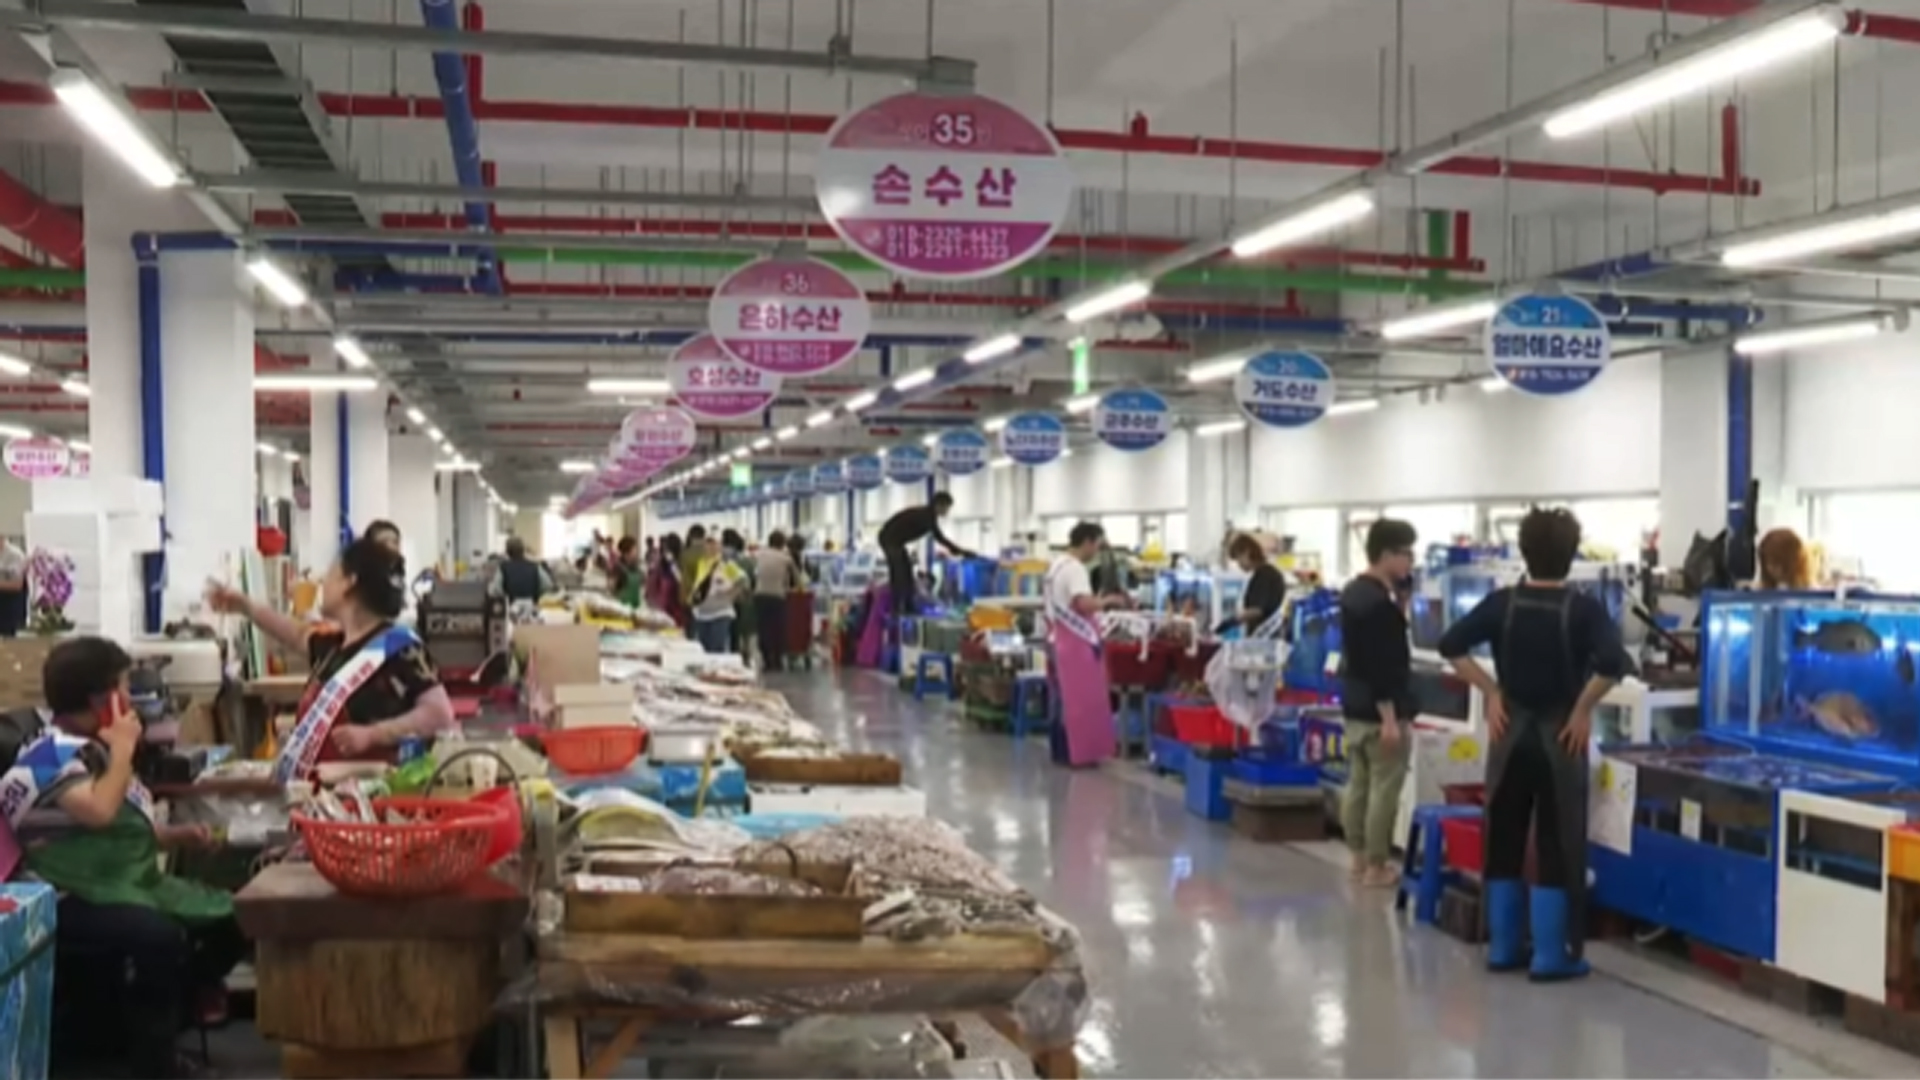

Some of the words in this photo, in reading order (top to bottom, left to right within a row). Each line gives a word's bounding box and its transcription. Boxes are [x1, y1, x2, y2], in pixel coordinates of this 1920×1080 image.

[933, 114, 975, 144] 35
[872, 163, 1017, 208] 손수산
[783, 273, 809, 293] 36
[738, 303, 842, 332] 은하수산
